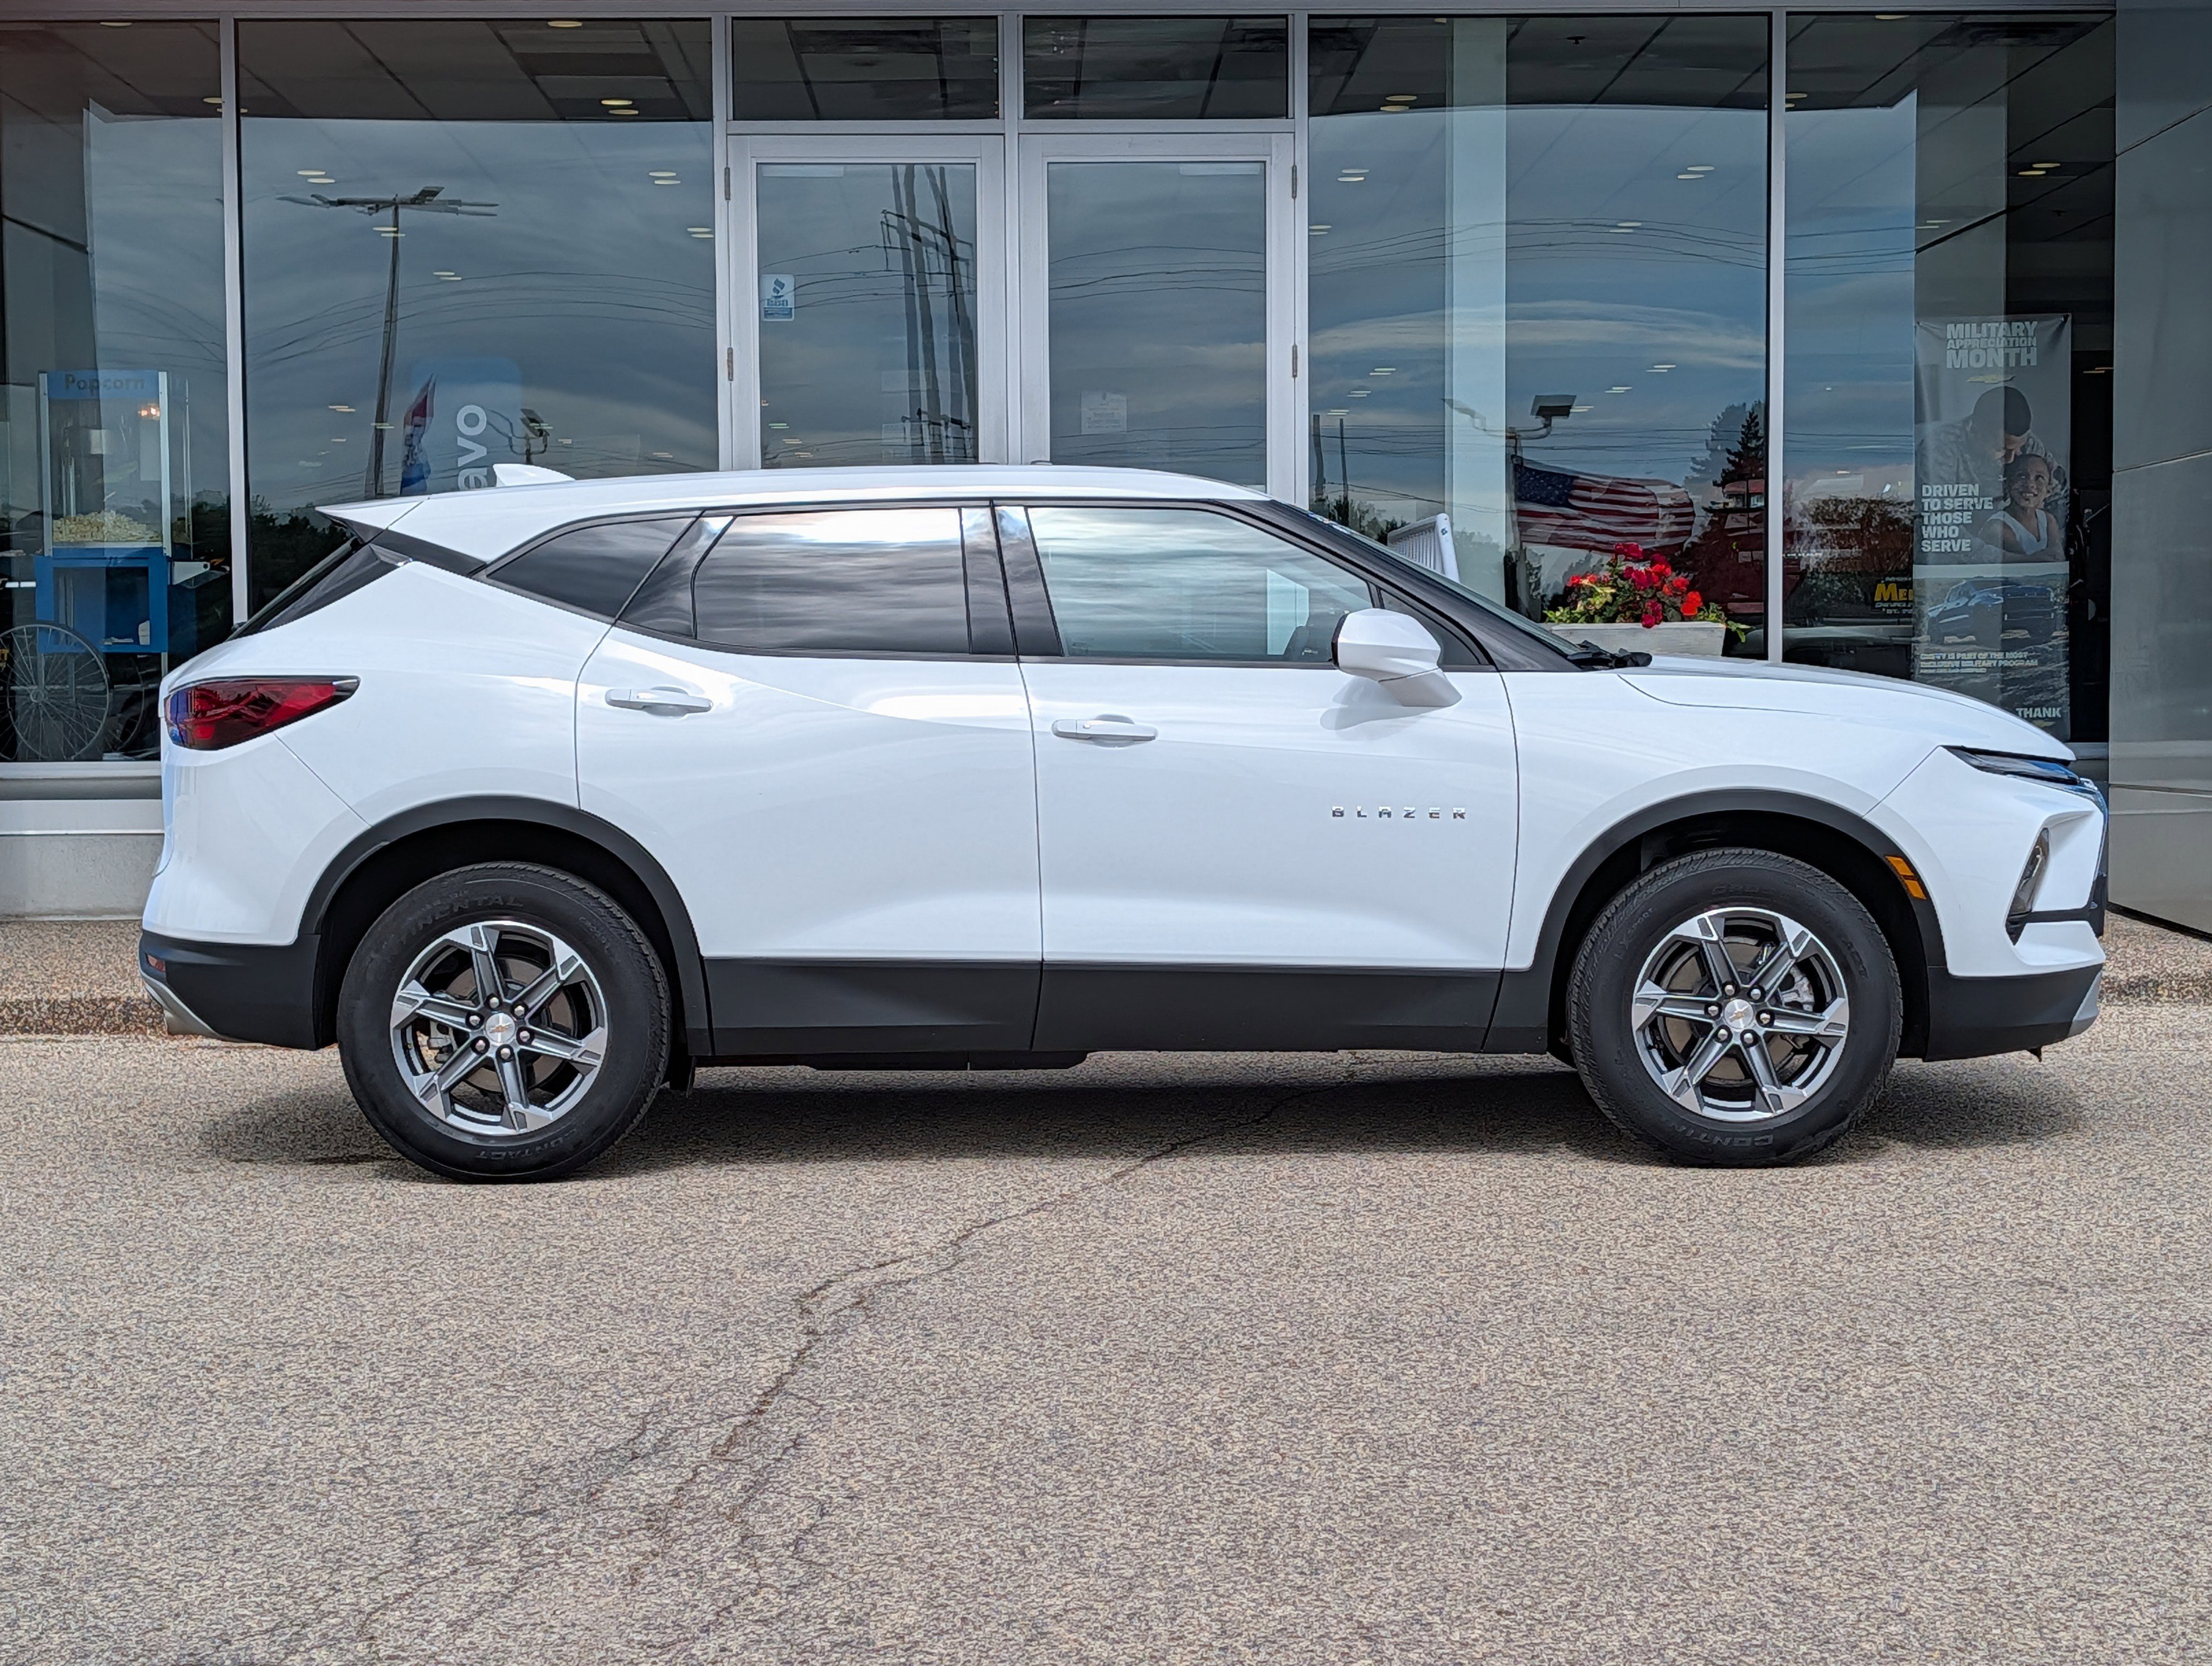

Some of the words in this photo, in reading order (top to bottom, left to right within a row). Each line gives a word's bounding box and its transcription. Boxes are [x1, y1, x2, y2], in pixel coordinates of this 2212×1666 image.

[1947, 321, 2037, 339] MILITARY
[1947, 337, 2037, 349] APPRECIATION
[1946, 347, 2037, 369] MONTH
[65, 374, 145, 396] Popcorn
[1922, 484, 1979, 497] DRIVEN
[1921, 498, 1941, 511] TO
[1943, 497, 1994, 510] SERVE
[1921, 511, 1972, 525] THOSE
[1921, 526, 1959, 539] WHO
[1921, 539, 1971, 552] SERVE
[2015, 707, 2061, 718] THANK
[1332, 806, 1465, 819] BLAZER
